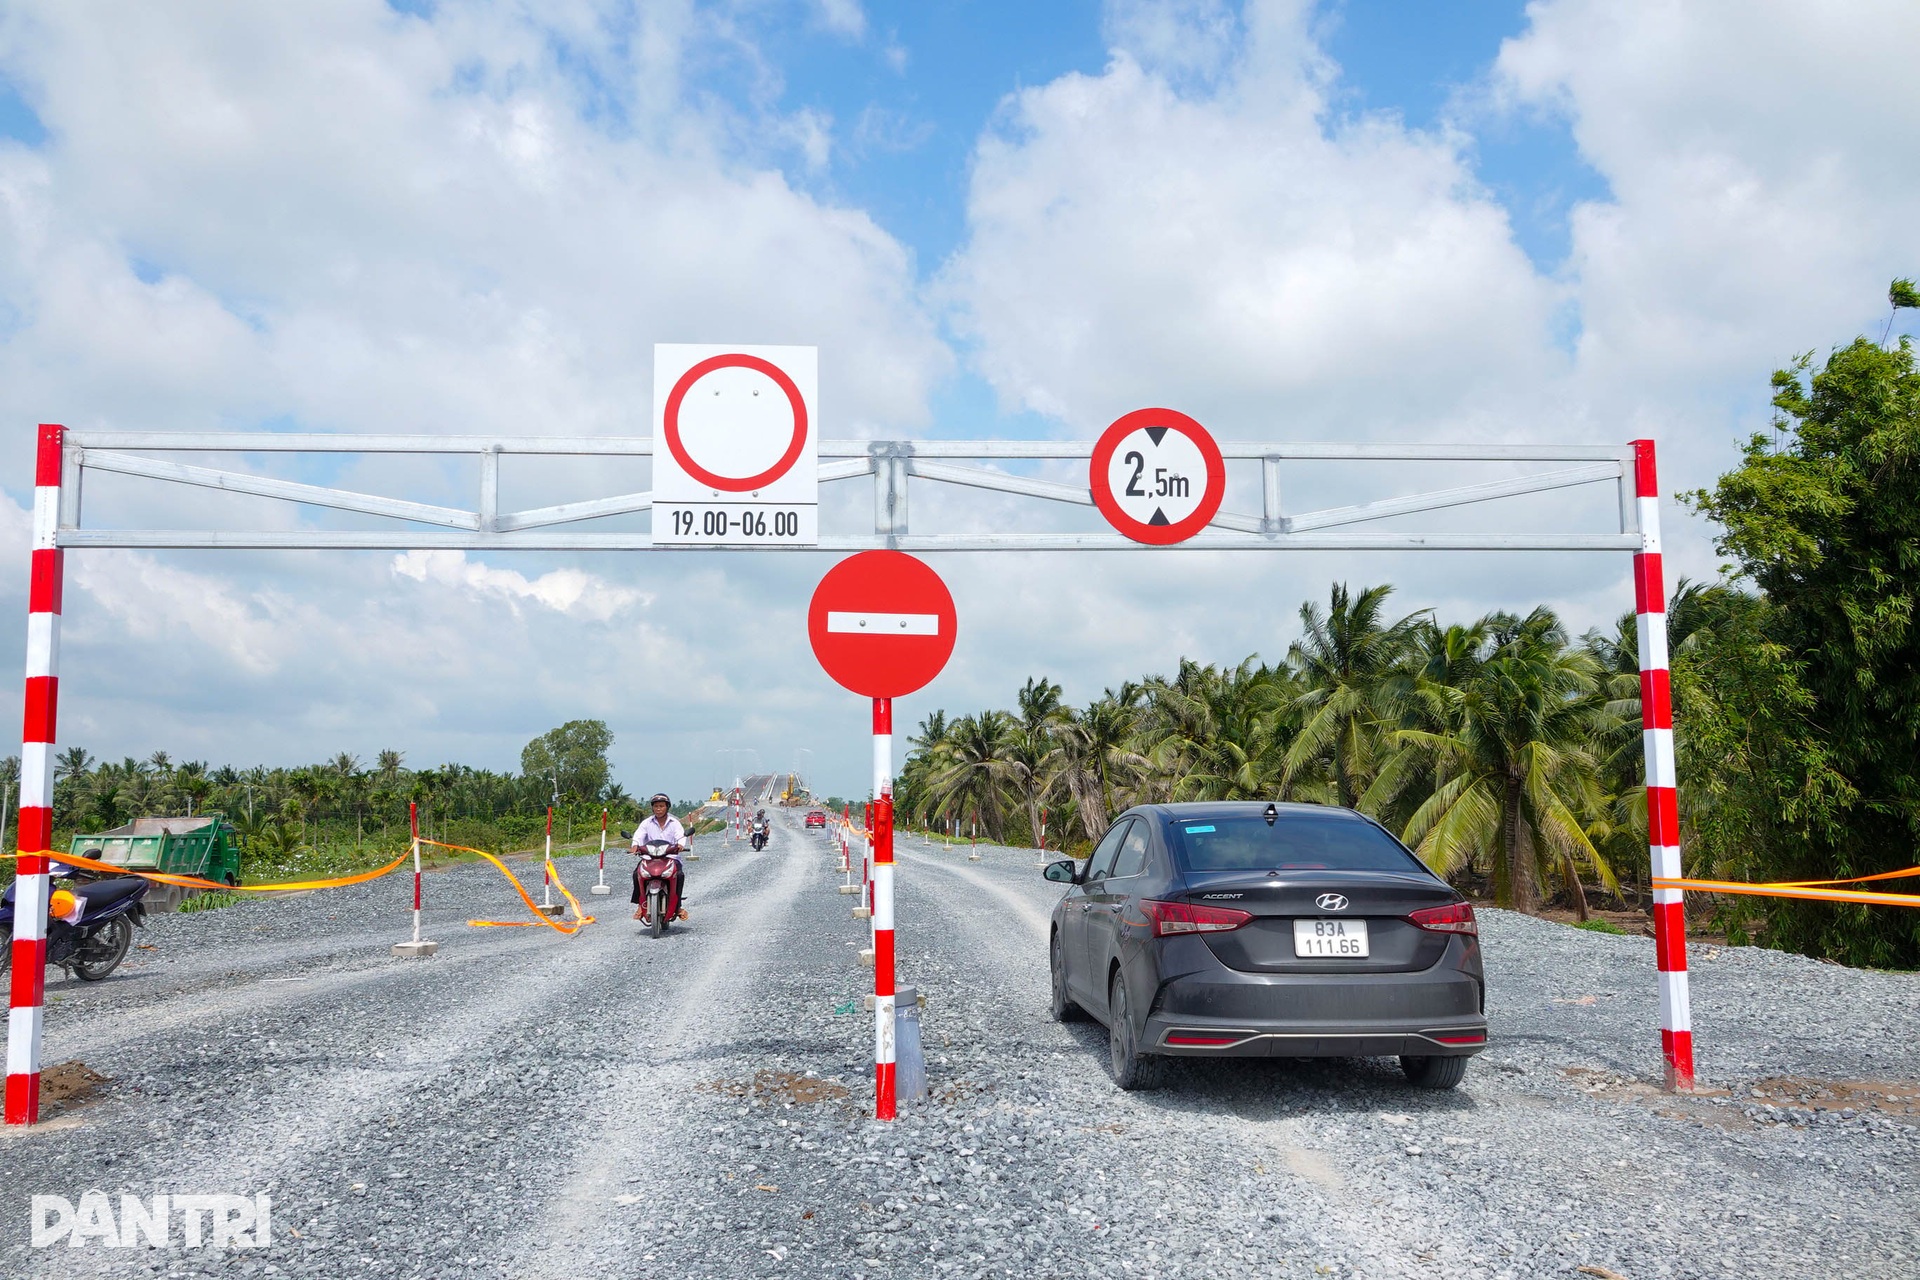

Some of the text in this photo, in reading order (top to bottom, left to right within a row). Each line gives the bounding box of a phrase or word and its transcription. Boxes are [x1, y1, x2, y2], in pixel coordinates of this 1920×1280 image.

[1124, 450, 1189, 499] 2,5m
[671, 510, 799, 537] 19.00-06.00
[1315, 921, 1345, 937] 83A
[1306, 939, 1360, 954] 111.66
